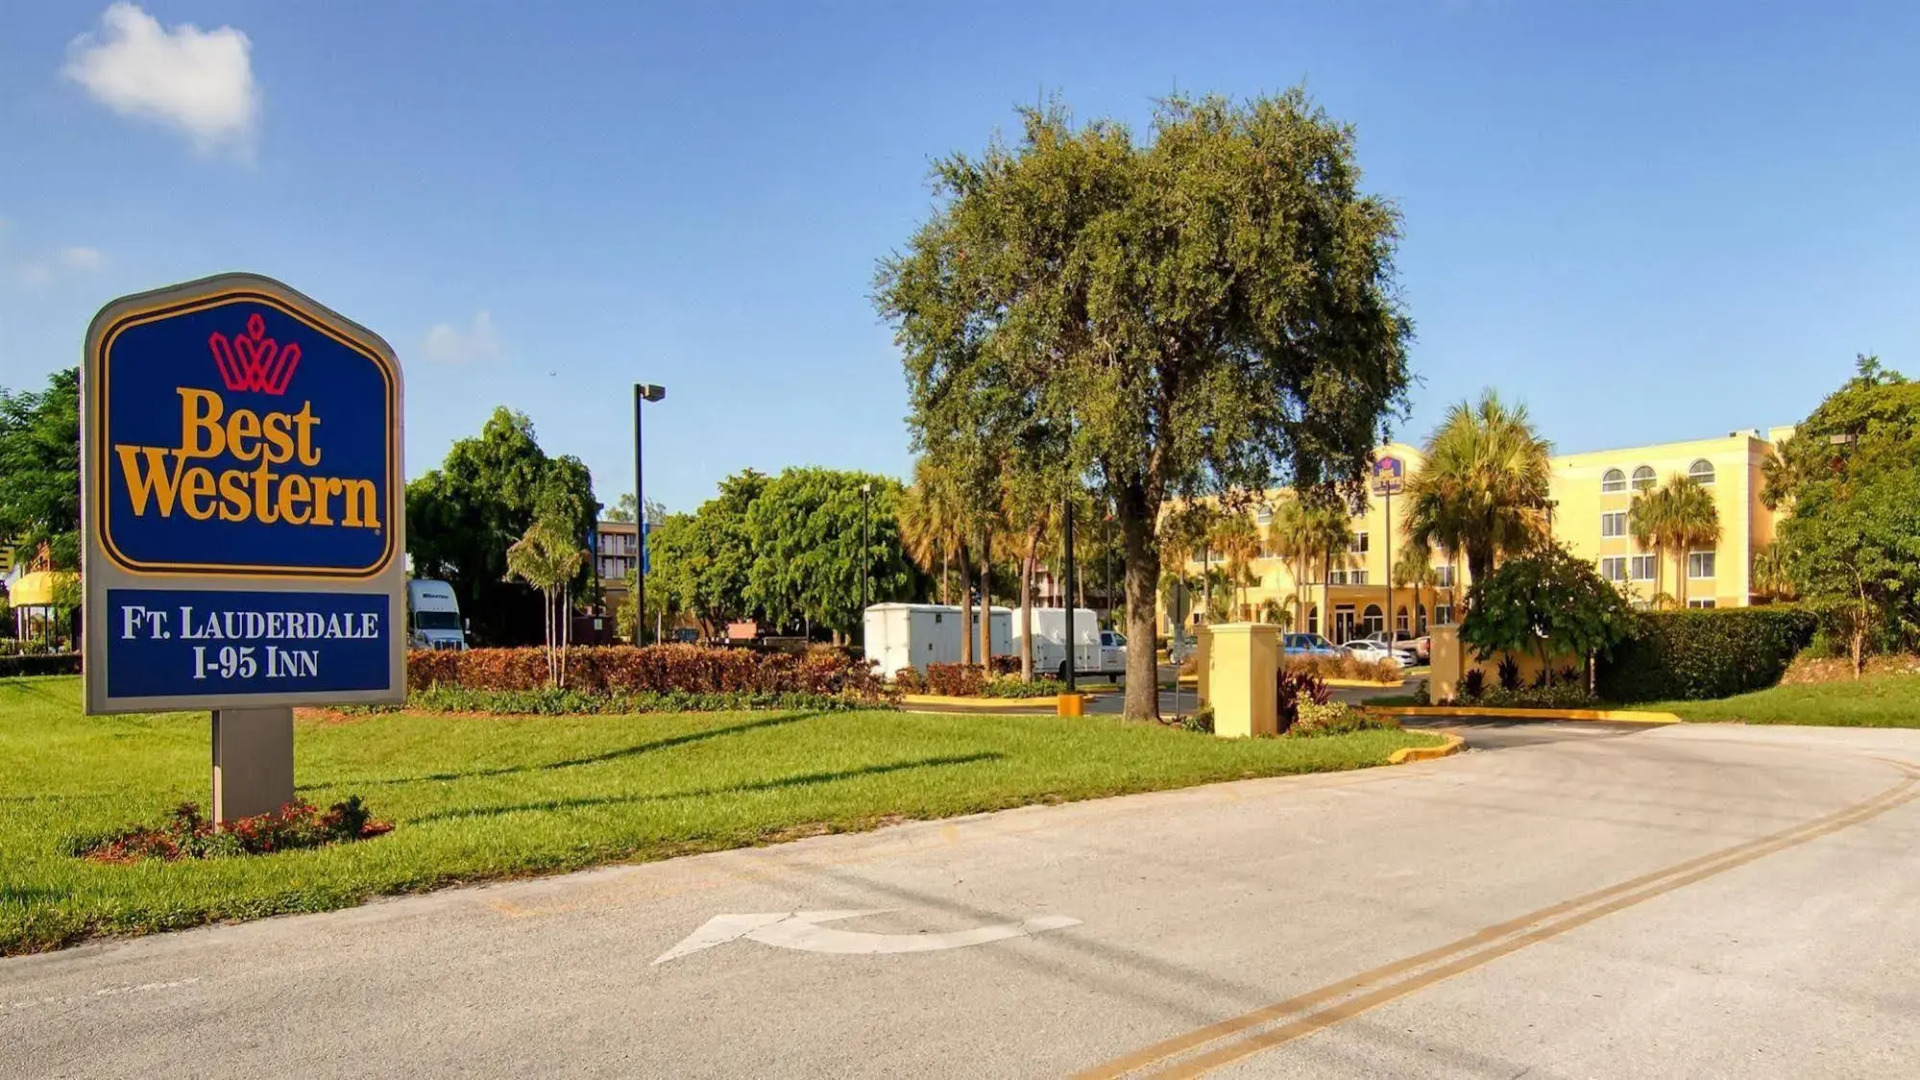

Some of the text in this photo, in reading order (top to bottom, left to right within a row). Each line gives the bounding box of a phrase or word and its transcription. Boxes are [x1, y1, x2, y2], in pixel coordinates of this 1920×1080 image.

[177, 387, 321, 466] Best
[114, 443, 382, 529] Western
[193, 646, 257, 680] I-95
